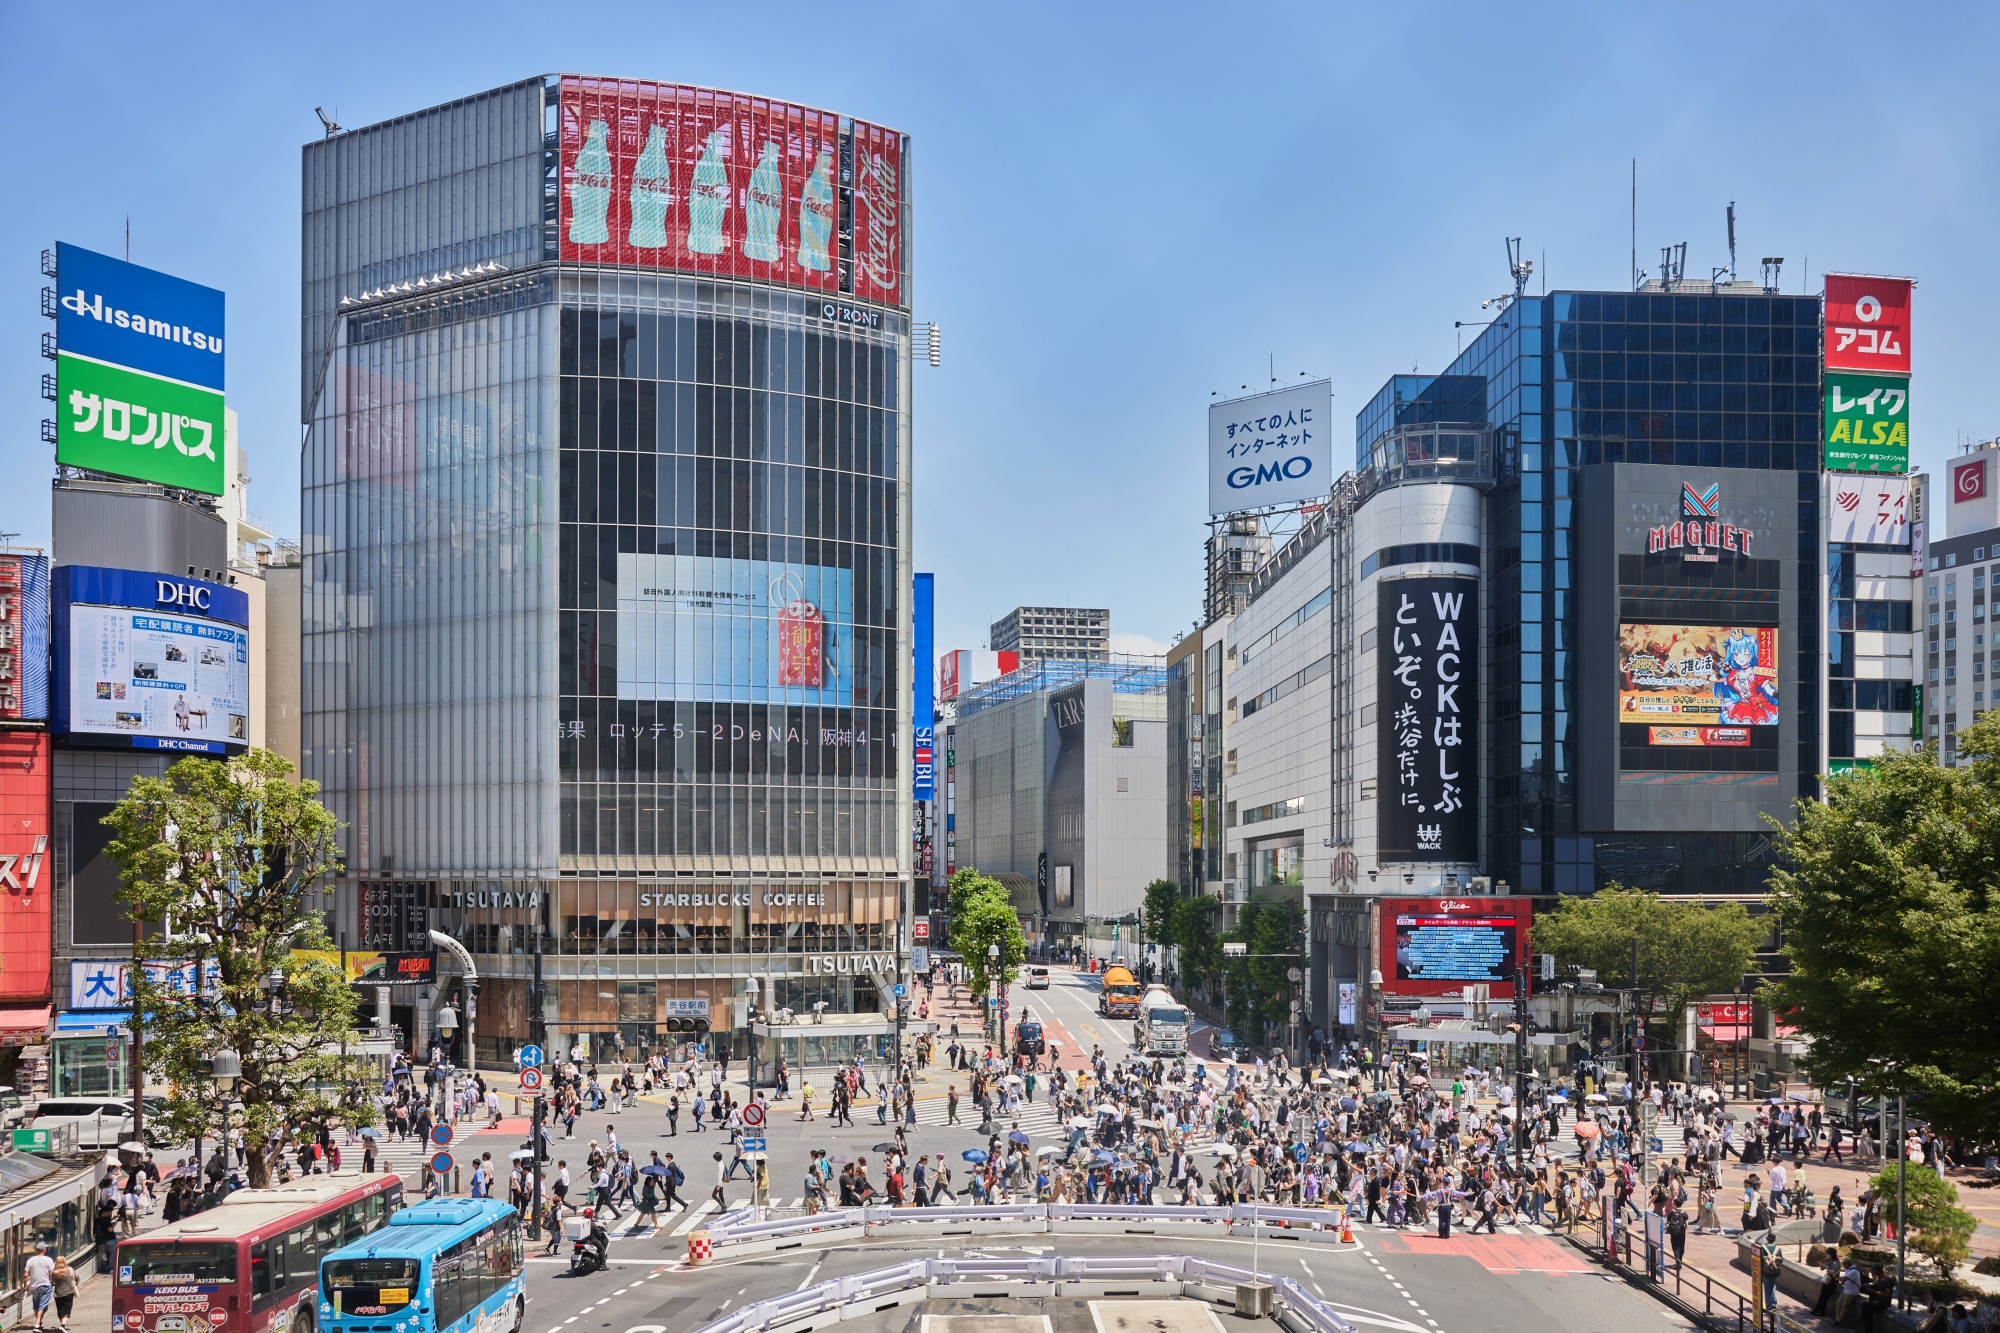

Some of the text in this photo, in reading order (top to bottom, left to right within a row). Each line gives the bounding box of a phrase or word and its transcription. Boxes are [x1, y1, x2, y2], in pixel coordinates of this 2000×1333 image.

[61, 289, 222, 354] Hisamitsu
[1835, 327, 1901, 355] アコム
[1832, 386, 1905, 416] レイク
[69, 389, 215, 462] サロンパス
[1226, 408, 1312, 439] すべての人に
[1829, 419, 1906, 446] ALSA
[1226, 428, 1312, 458] インターネット
[1829, 451, 1866, 460] 新生銀行グループ
[1226, 456, 1312, 489] GMO
[1649, 521, 1753, 556] MAGNET
[157, 580, 211, 609] DHC
[135, 617, 235, 641] 宅配購読者 無料プラン
[158, 739, 208, 751] DHC Channel
[1417, 842, 1441, 850] WACK
[454, 891, 538, 908] TSUTAYA
[641, 893, 826, 907] STARBUCKS COFFEE
[1440, 900, 1470, 913] Glico
[917, 925, 927, 935] 本
[808, 955, 897, 974] TSUTAYA
[669, 1001, 706, 1009] 渋谷駅前
[145, 1303, 209, 1313] ヨドバシカメラ
